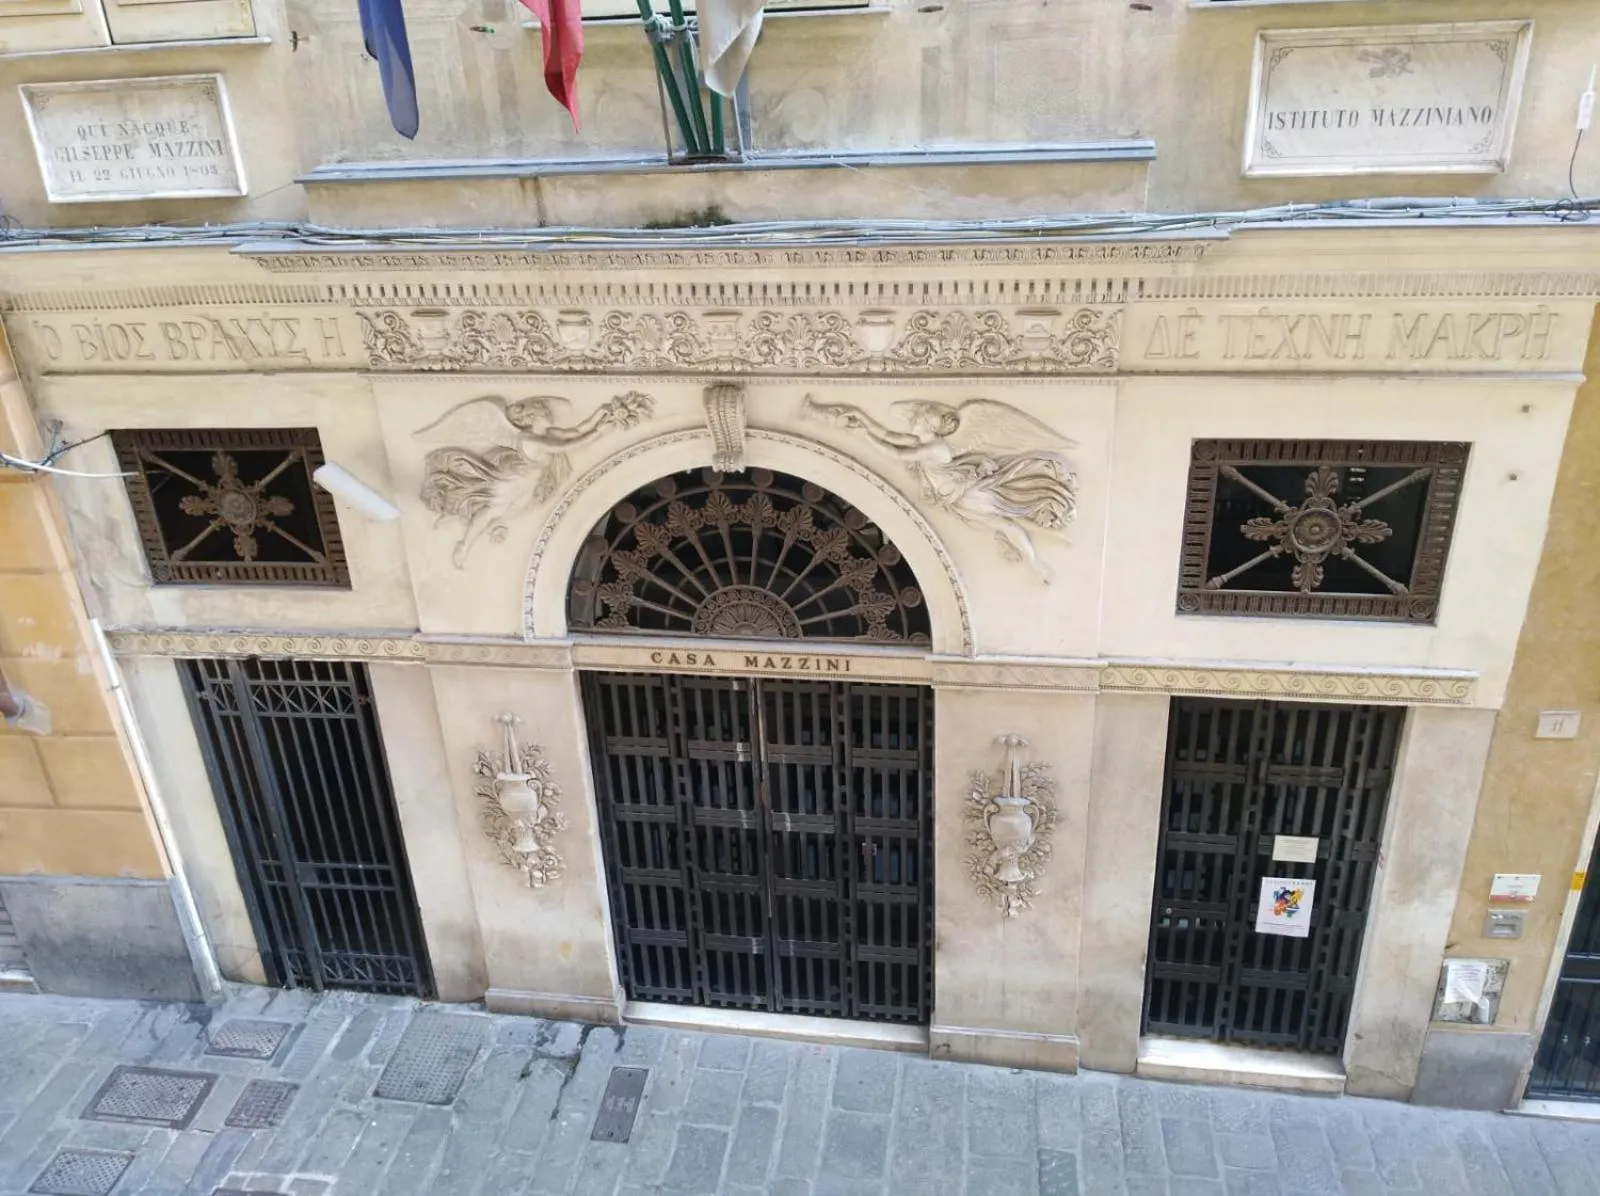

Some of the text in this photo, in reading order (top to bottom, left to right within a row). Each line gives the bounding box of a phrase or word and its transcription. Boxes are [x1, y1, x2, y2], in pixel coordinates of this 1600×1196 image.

[1268, 105, 1492, 129] ISTITUTO MAZZINIANO
[117, 119, 190, 138] NACQUE
[53, 138, 225, 163] GIUSEPPE MAZZINI
[70, 168, 86, 182] IL
[93, 167, 111, 181] 22
[119, 165, 175, 180] GIUGNO
[650, 651, 851, 672] CASA MAZZINI
